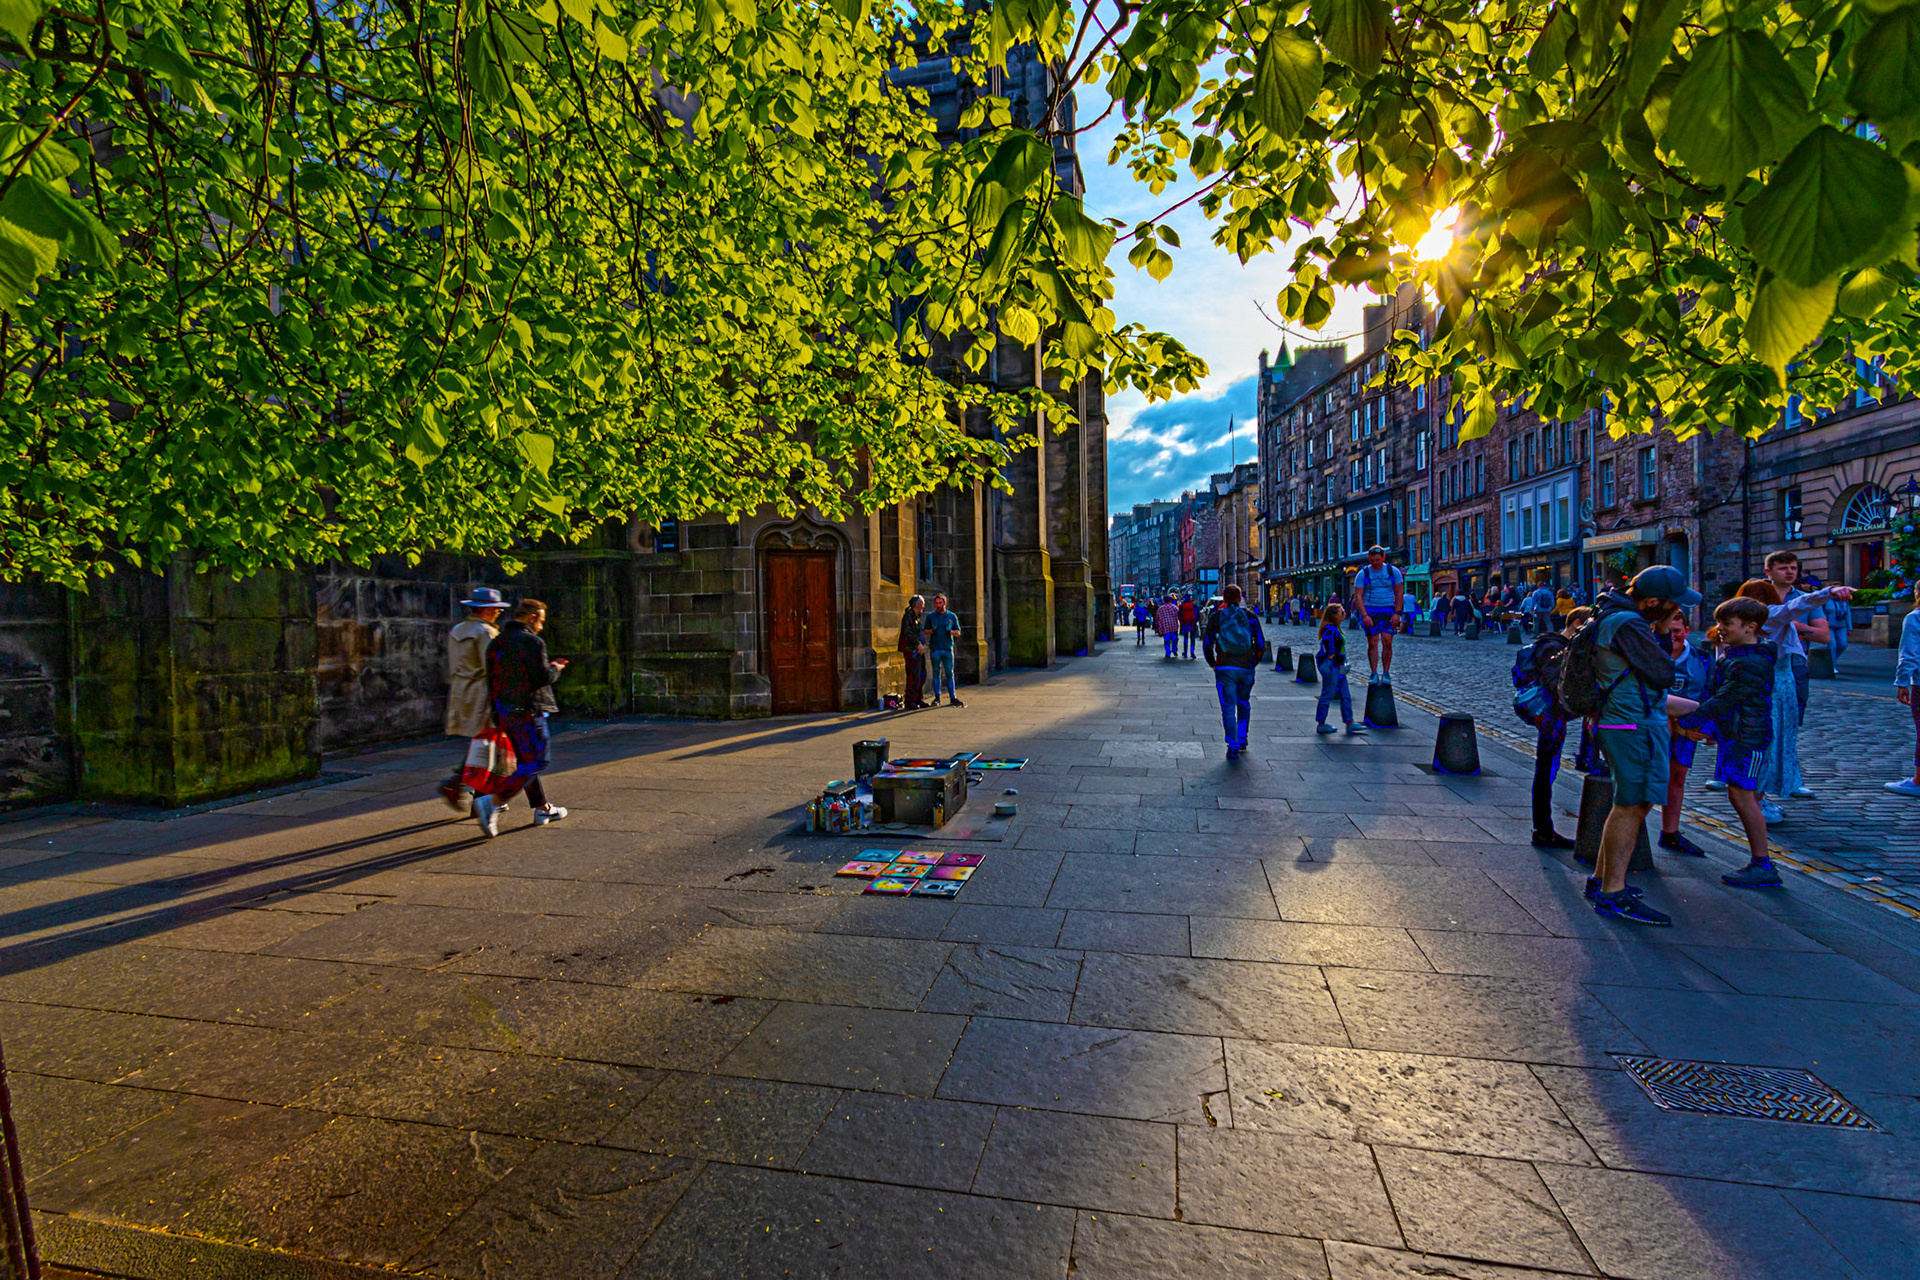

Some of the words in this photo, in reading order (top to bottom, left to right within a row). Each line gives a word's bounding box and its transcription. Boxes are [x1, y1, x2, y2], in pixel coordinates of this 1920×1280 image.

[1845, 525, 1862, 533] TOWN
[1863, 522, 1886, 531] CHAMB
[1694, 1071, 1758, 1085] FIRE
[1688, 1092, 1817, 1113] HYDRANT
